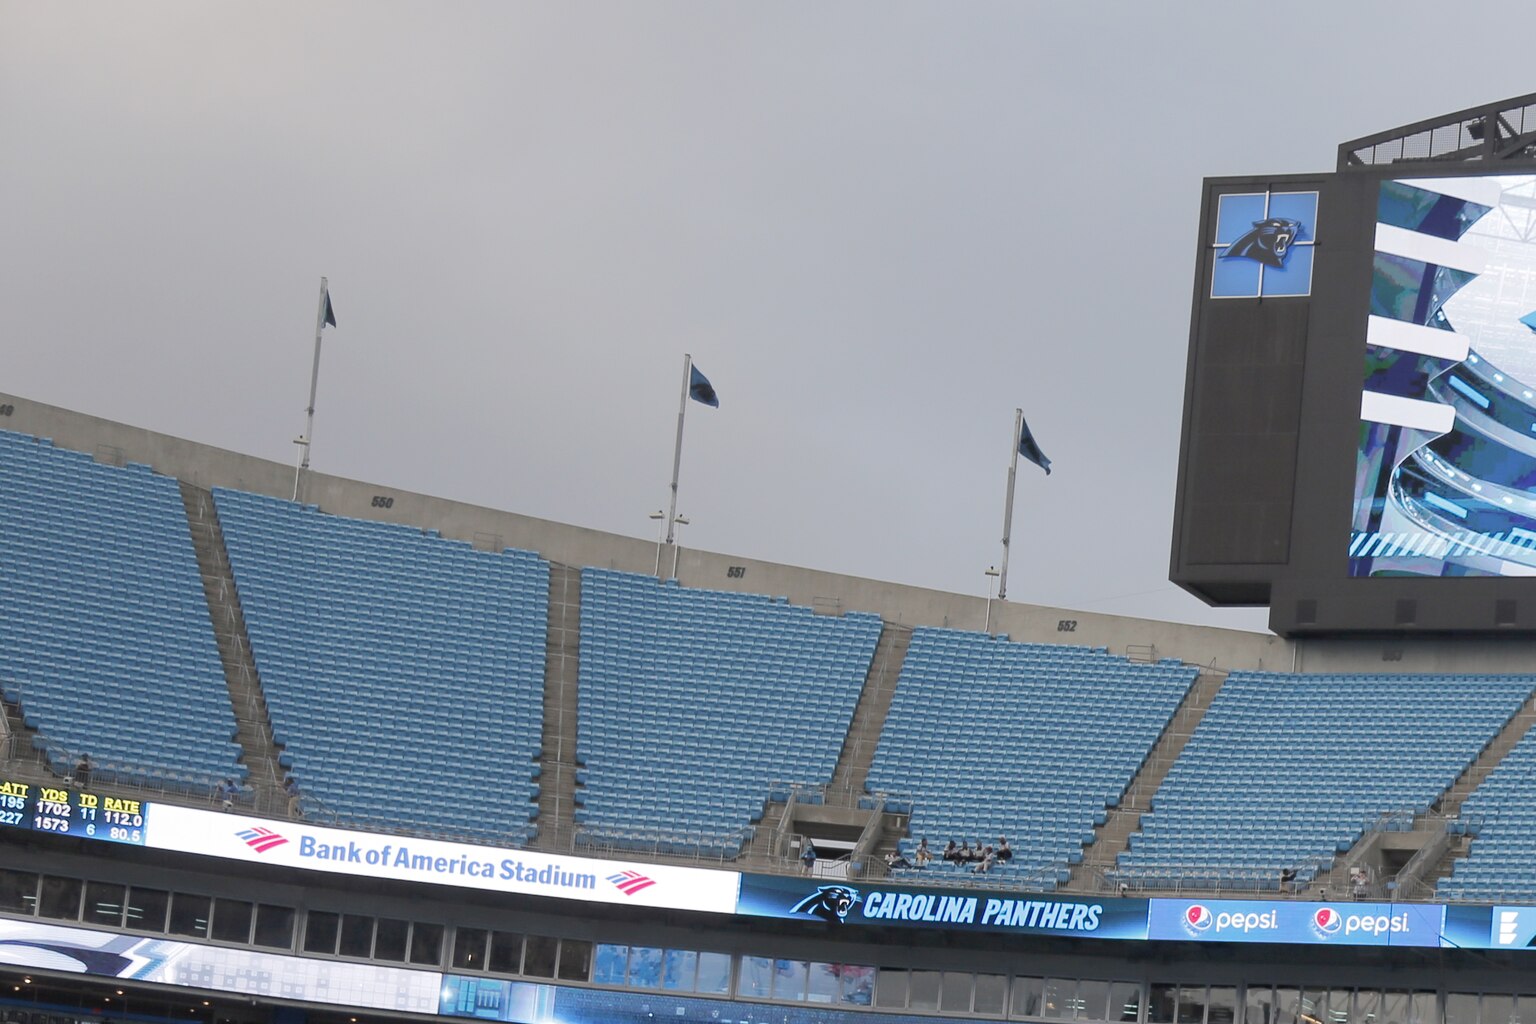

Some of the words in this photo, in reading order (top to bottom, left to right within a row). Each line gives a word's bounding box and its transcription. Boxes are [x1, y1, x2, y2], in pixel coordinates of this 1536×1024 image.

[371, 496, 395, 509] 550
[727, 566, 747, 579] 551
[1057, 620, 1078, 632] 552
[41, 788, 68, 801] YDS
[79, 793, 98, 806] TD
[104, 797, 140, 812] RATE
[36, 802, 71, 817] 1702
[81, 808, 96, 821] 11
[105, 811, 143, 827] 112.0
[35, 816, 69, 832] 1573
[86, 824, 96, 836] 6
[110, 827, 141, 842] 80.5
[298, 836, 360, 864] Bank
[364, 844, 393, 866] of
[393, 847, 495, 879] America
[499, 859, 597, 890] Stadium
[862, 890, 977, 925] CAROLINA
[981, 900, 1104, 932] PANTHERS
[1216, 909, 1277, 933] pepsi
[1345, 911, 1408, 936] pepsi
